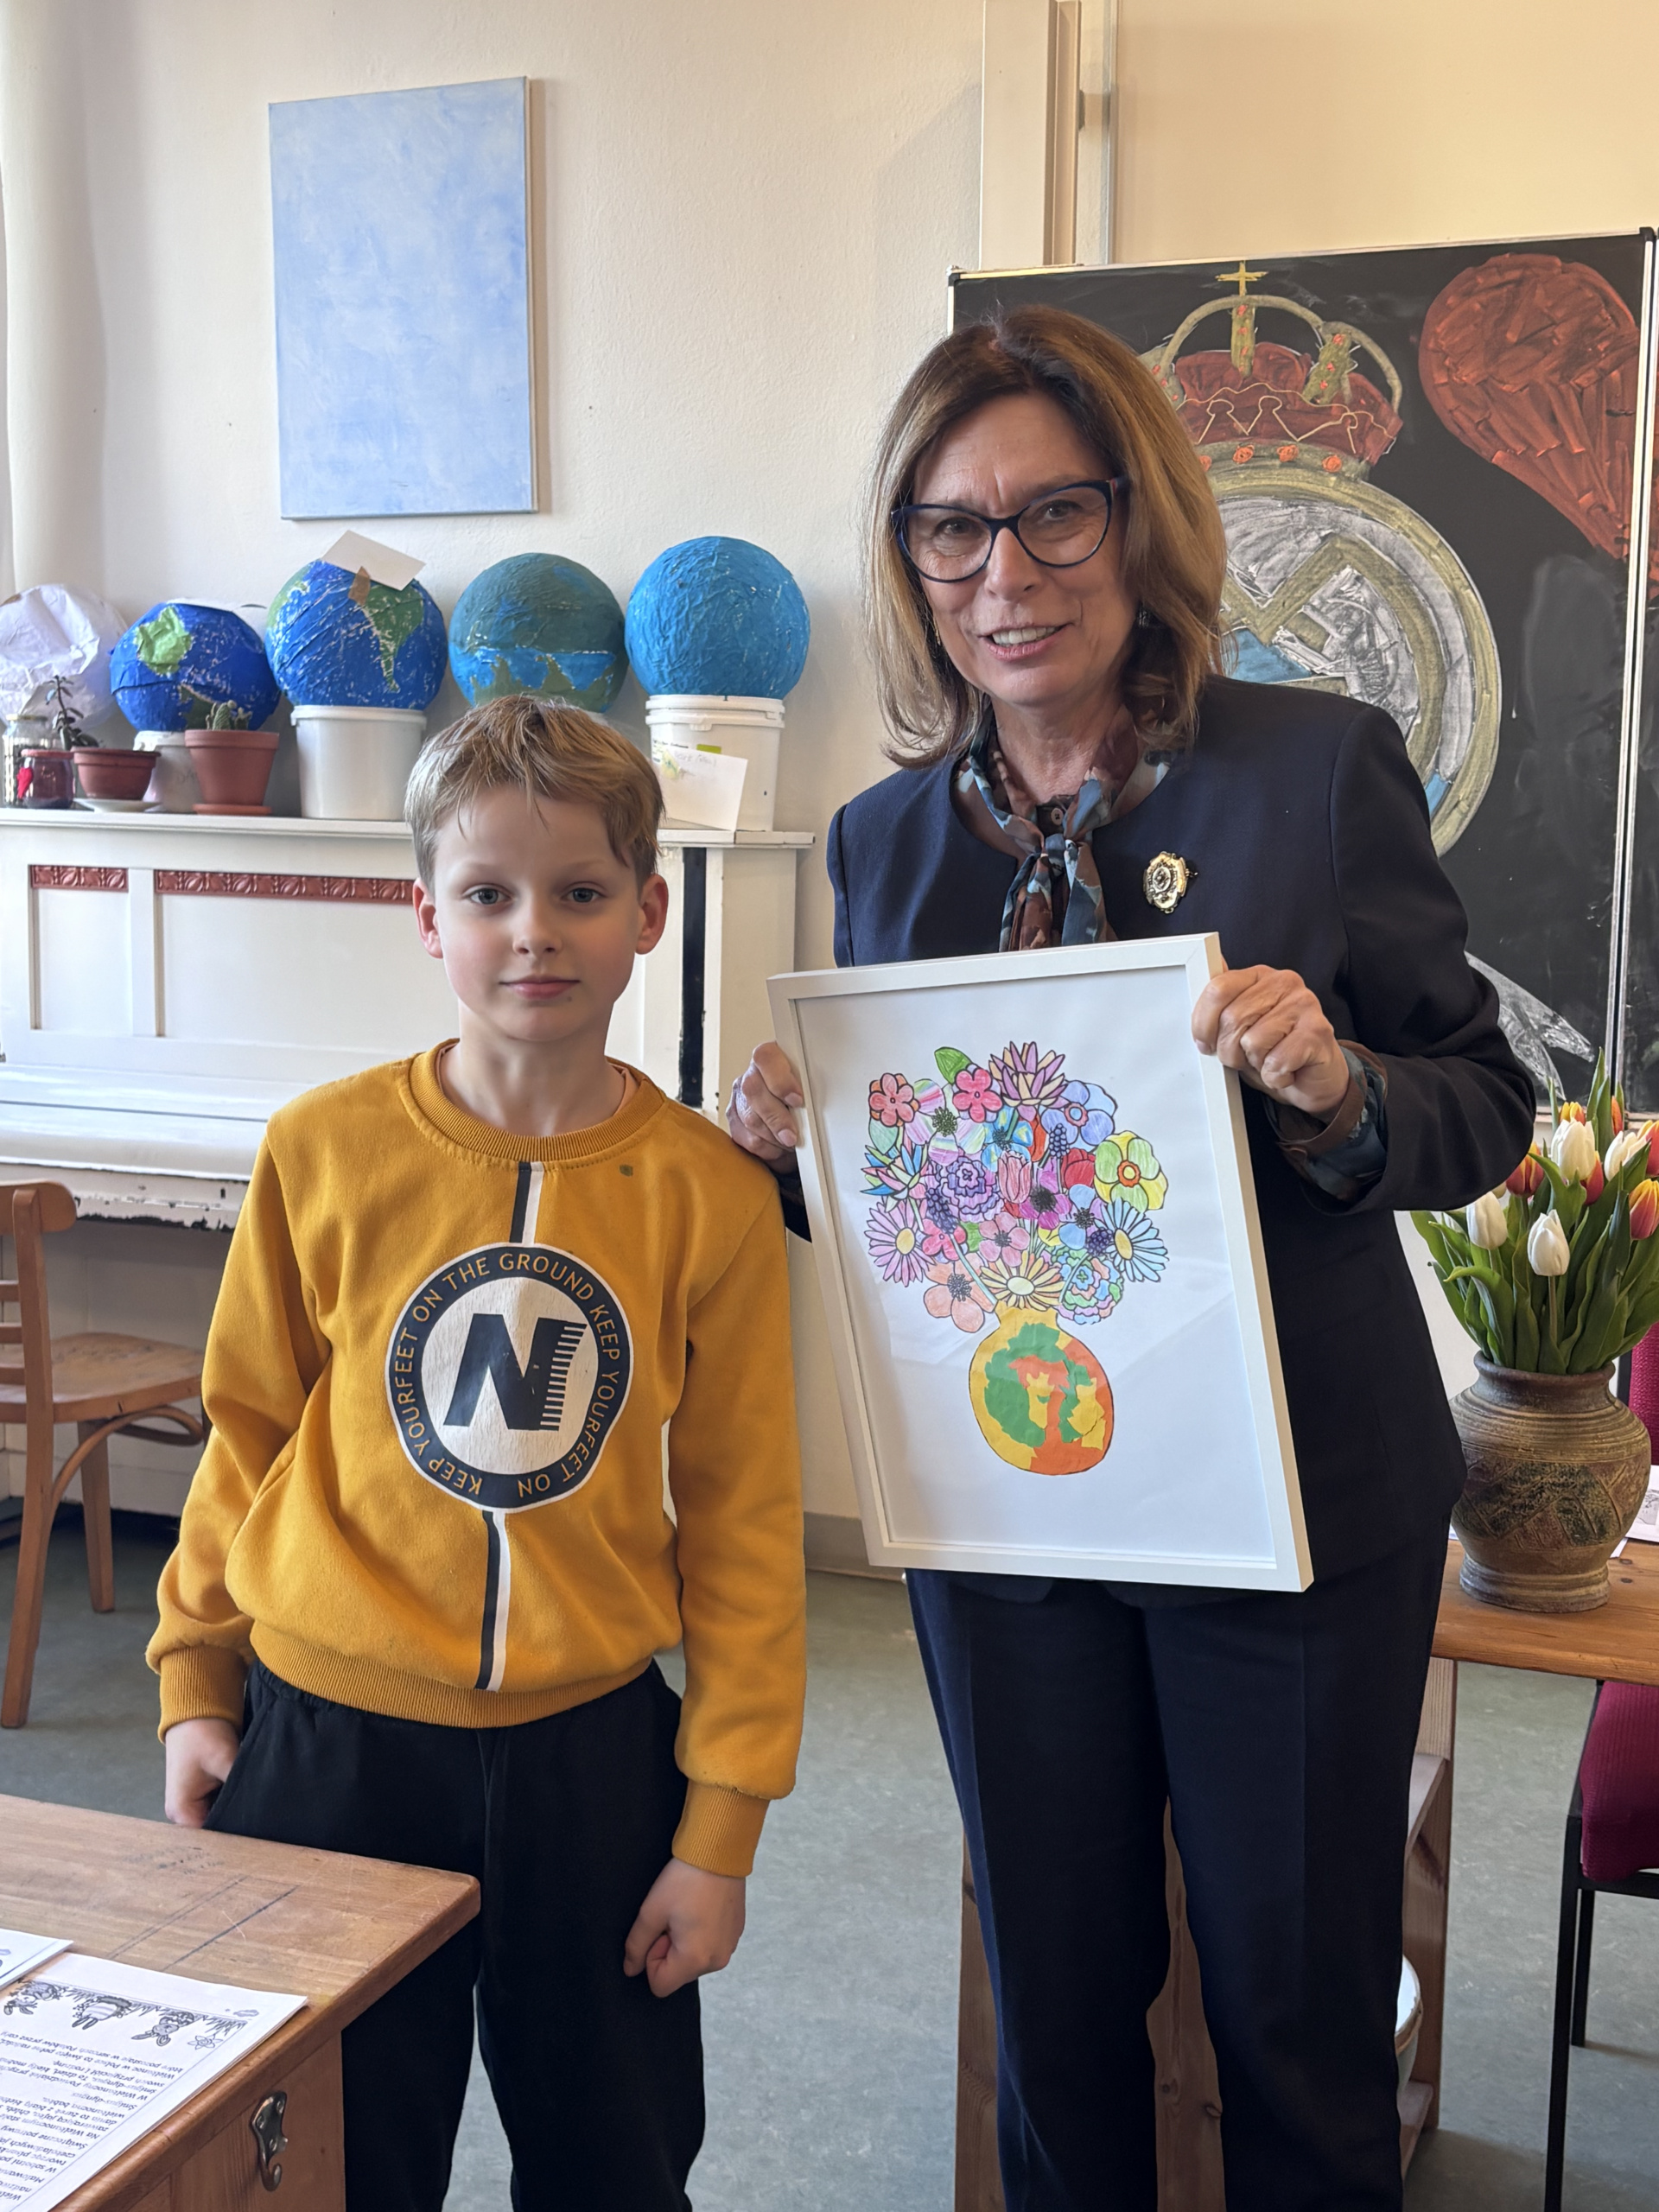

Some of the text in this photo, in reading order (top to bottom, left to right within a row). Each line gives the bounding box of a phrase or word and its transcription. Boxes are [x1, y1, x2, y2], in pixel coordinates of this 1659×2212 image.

[442, 1257, 490, 1290] THE
[499, 1254, 594, 1300] GROUND
[412, 1289, 443, 1323] ON
[589, 1305, 620, 1361] KEEP
[443, 1313, 587, 1431] N
[429, 1458, 483, 1496] KEEP
[518, 1473, 550, 1497] ON
